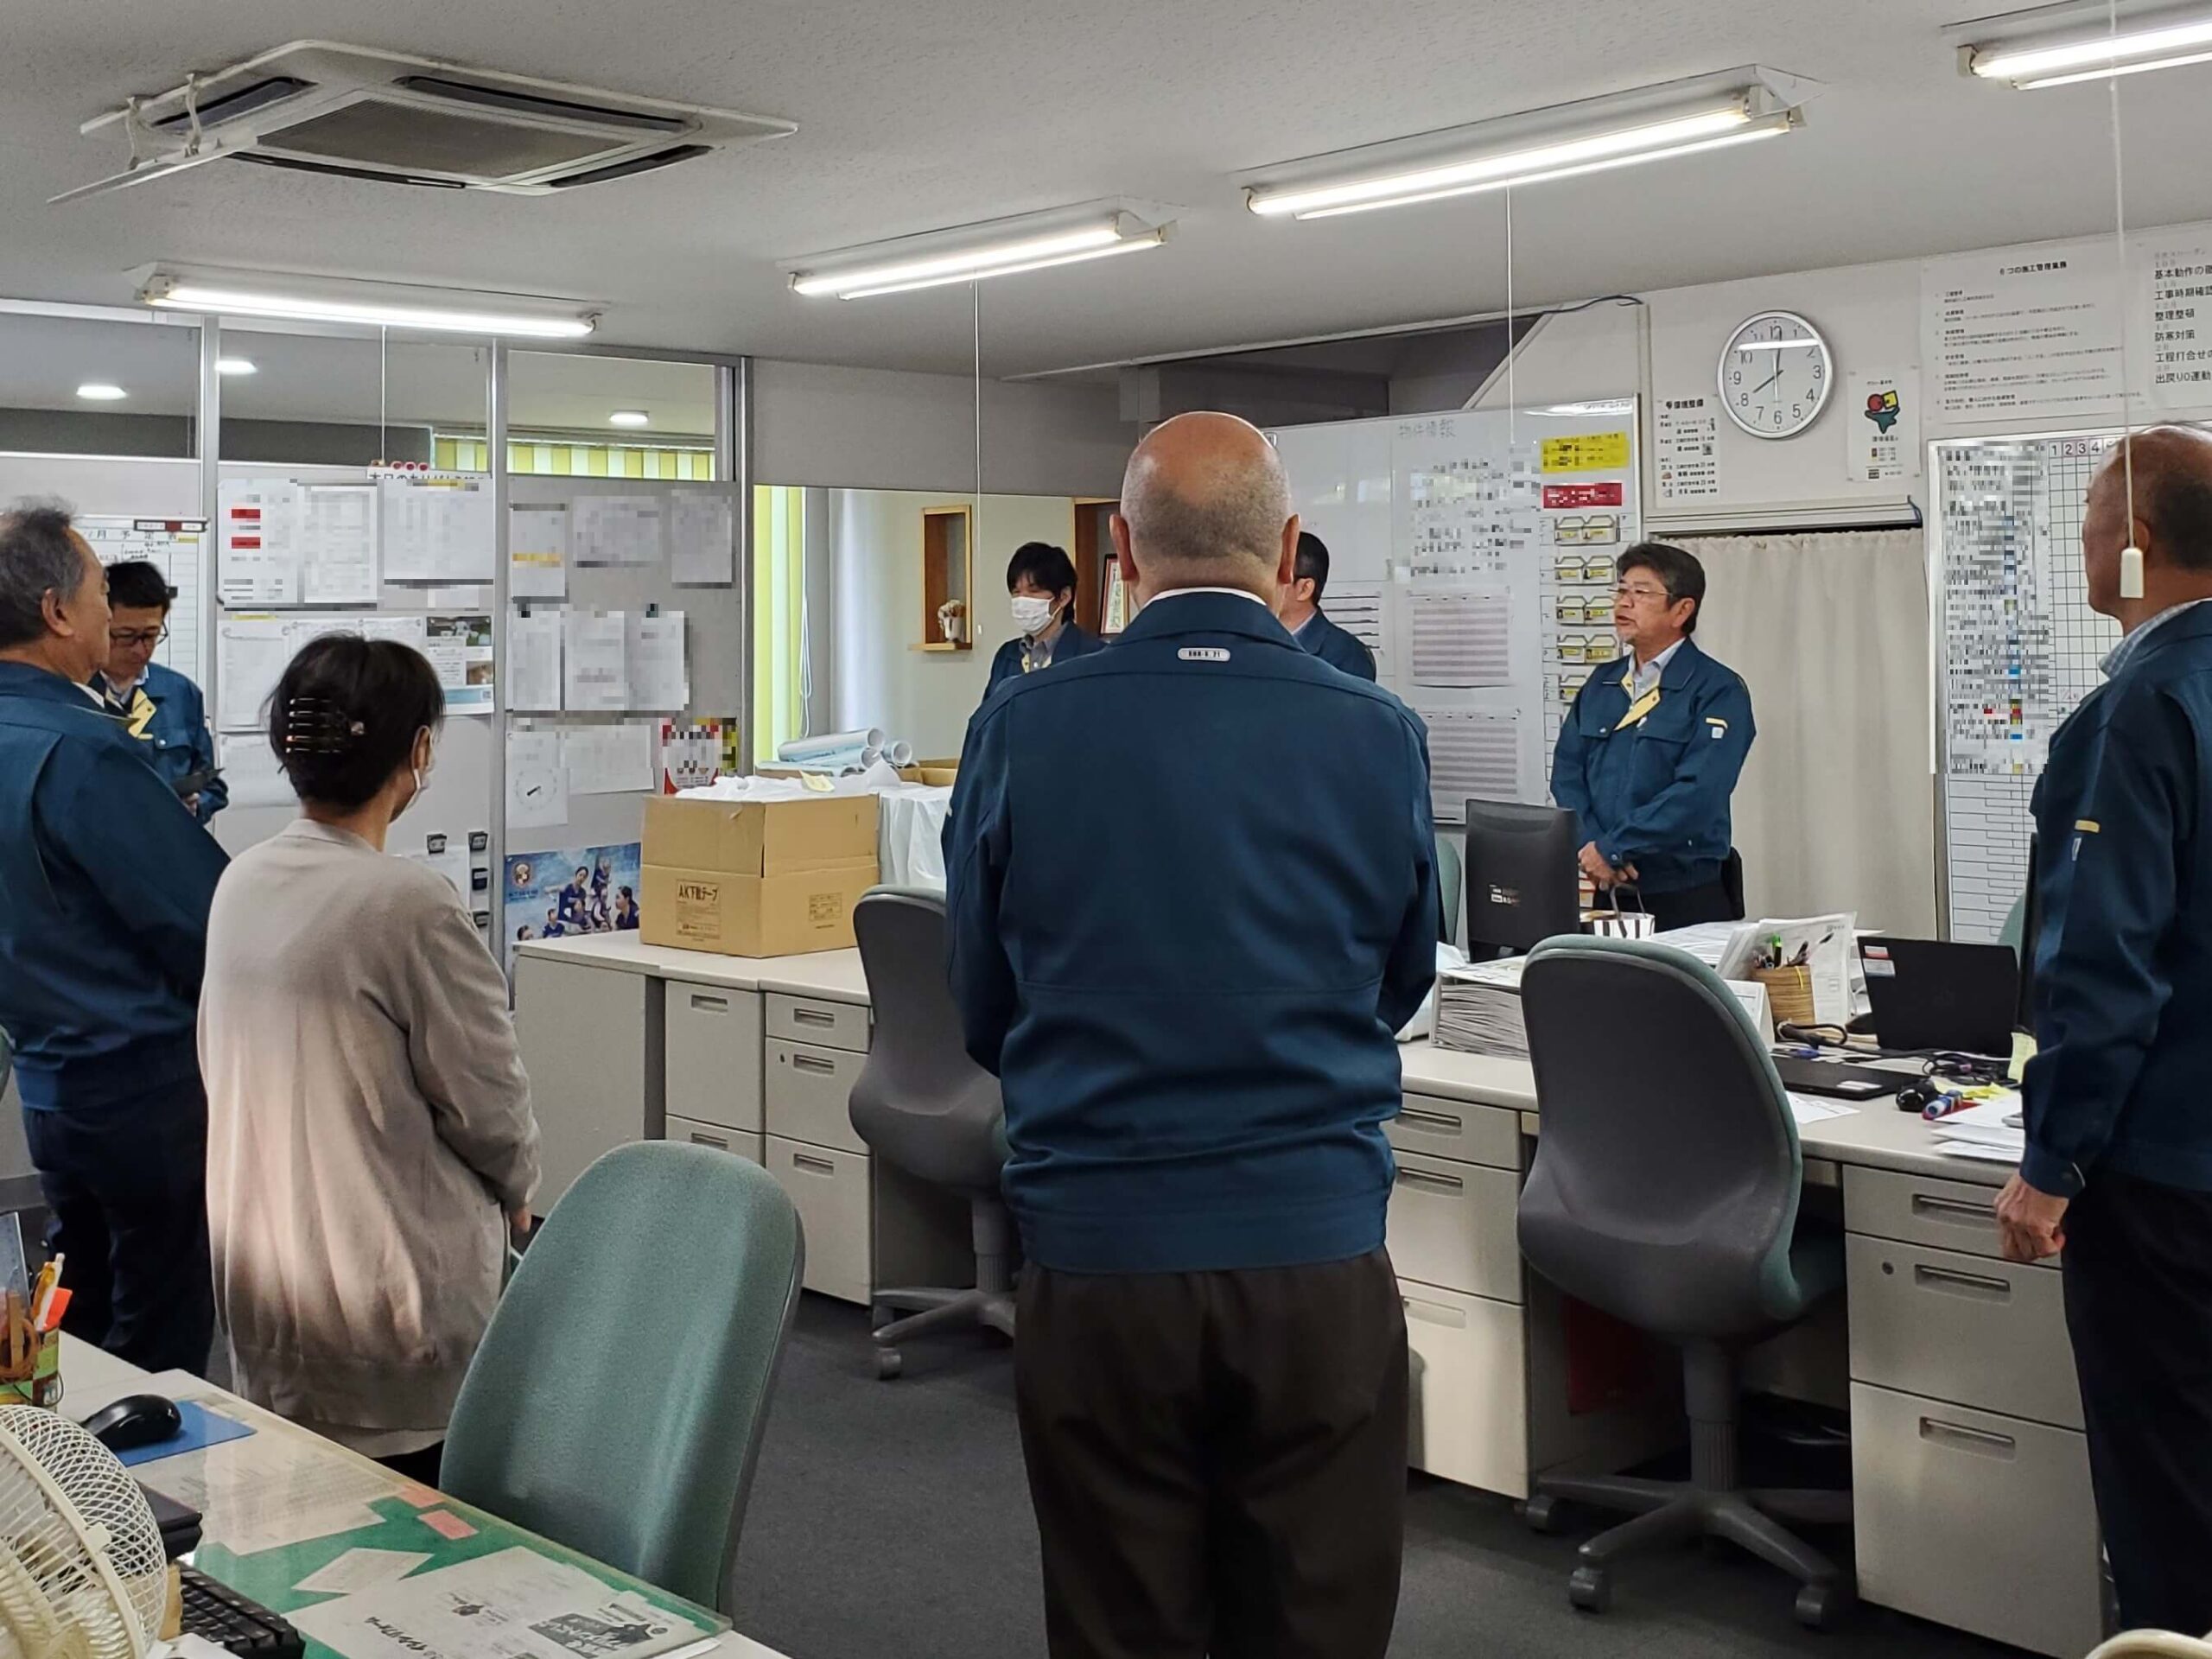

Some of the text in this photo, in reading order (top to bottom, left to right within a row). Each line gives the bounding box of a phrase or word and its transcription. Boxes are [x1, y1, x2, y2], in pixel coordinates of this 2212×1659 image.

[1739, 350, 1753, 365] 10
[1733, 371, 1742, 385] 9
[1813, 365, 1821, 379] 3
[1740, 392, 1749, 407] 8
[1806, 388, 1815, 402] 4
[1756, 406, 1764, 421] 7
[1774, 410, 1783, 425] 6
[1792, 404, 1802, 419] 5
[2051, 442, 2100, 456] 1 2 3 4
